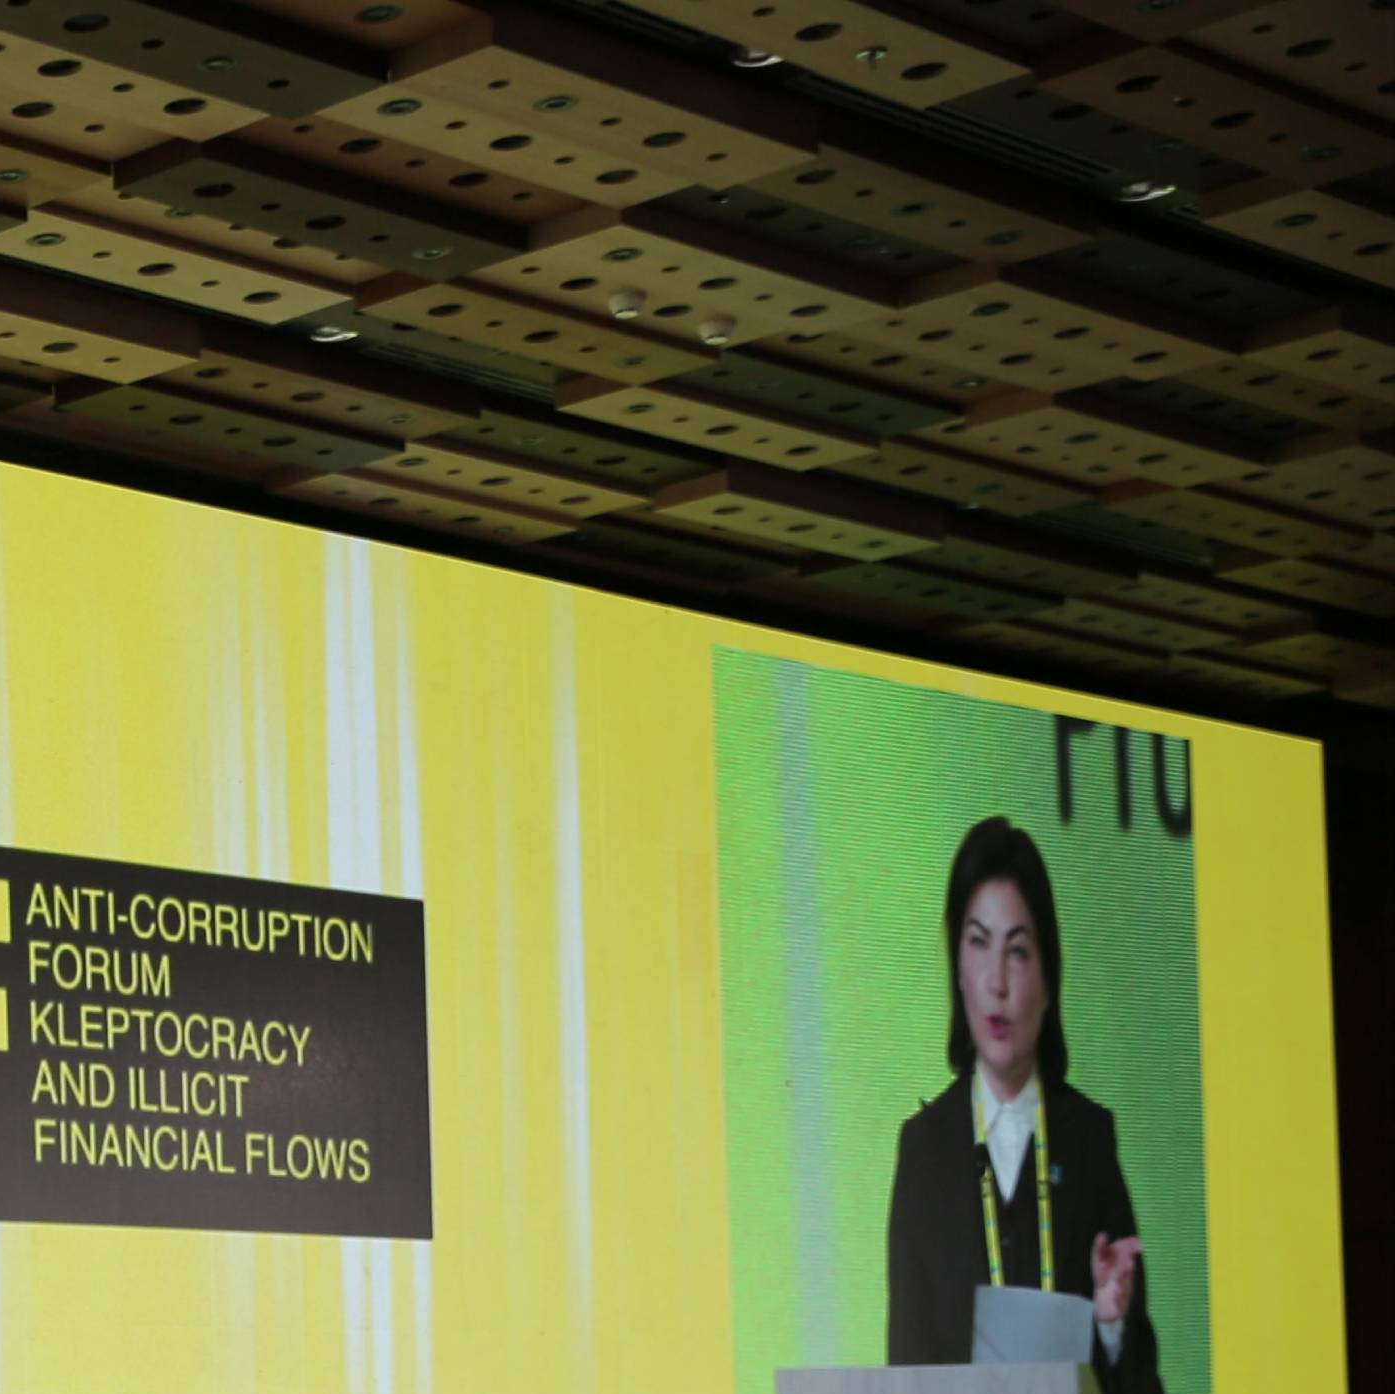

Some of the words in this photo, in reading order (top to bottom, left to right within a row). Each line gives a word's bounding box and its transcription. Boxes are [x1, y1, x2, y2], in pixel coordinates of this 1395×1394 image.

[26, 883, 374, 964] ANTI-CORRUPTION
[29, 941, 171, 998] FORUM
[30, 1001, 311, 1067] KLEPTOCRACY
[31, 1060, 115, 1109] AND
[128, 1067, 250, 1119] ILLICIT
[34, 1118, 236, 1174] FINANCIAL
[245, 1132, 371, 1183] FLOWS
